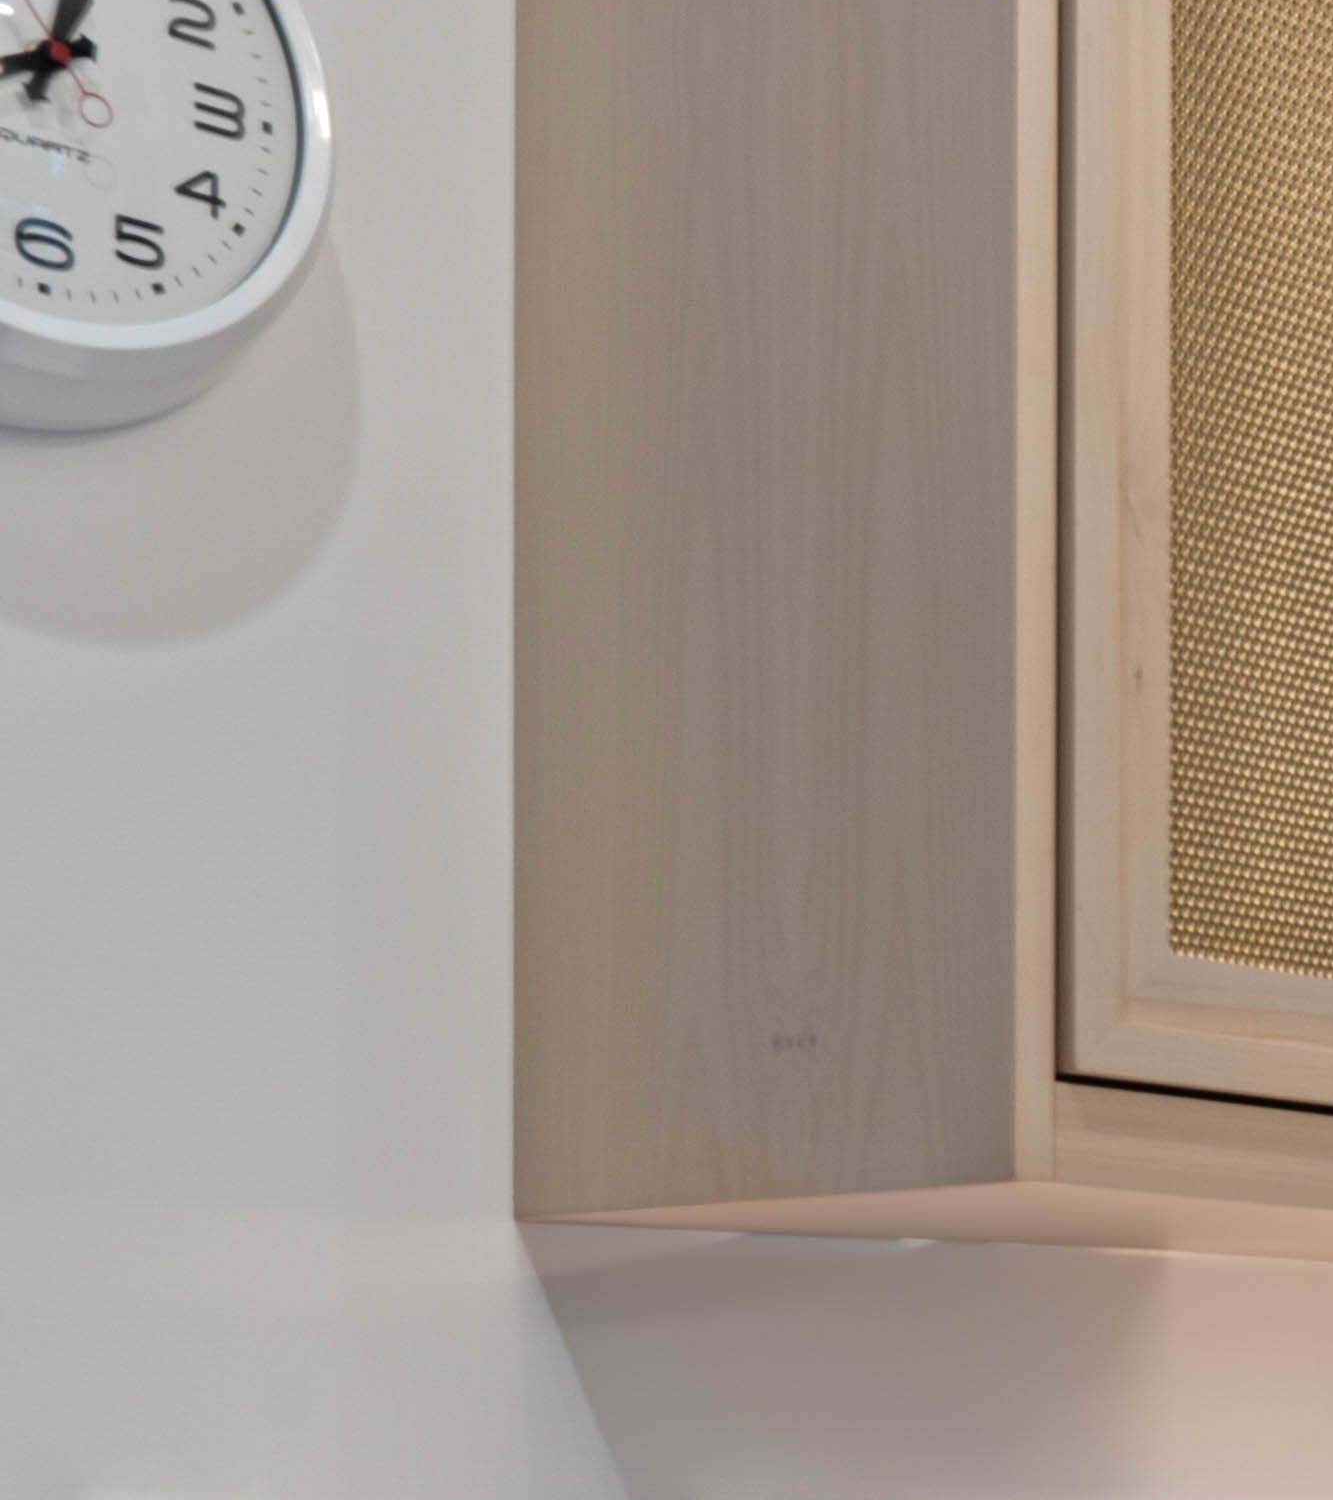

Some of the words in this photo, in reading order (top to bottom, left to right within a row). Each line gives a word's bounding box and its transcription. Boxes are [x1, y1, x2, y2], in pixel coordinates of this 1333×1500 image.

[194, 82, 245, 141] 3
[174, 170, 226, 219] 4
[14, 218, 74, 271] 6
[114, 214, 165, 270] 5
